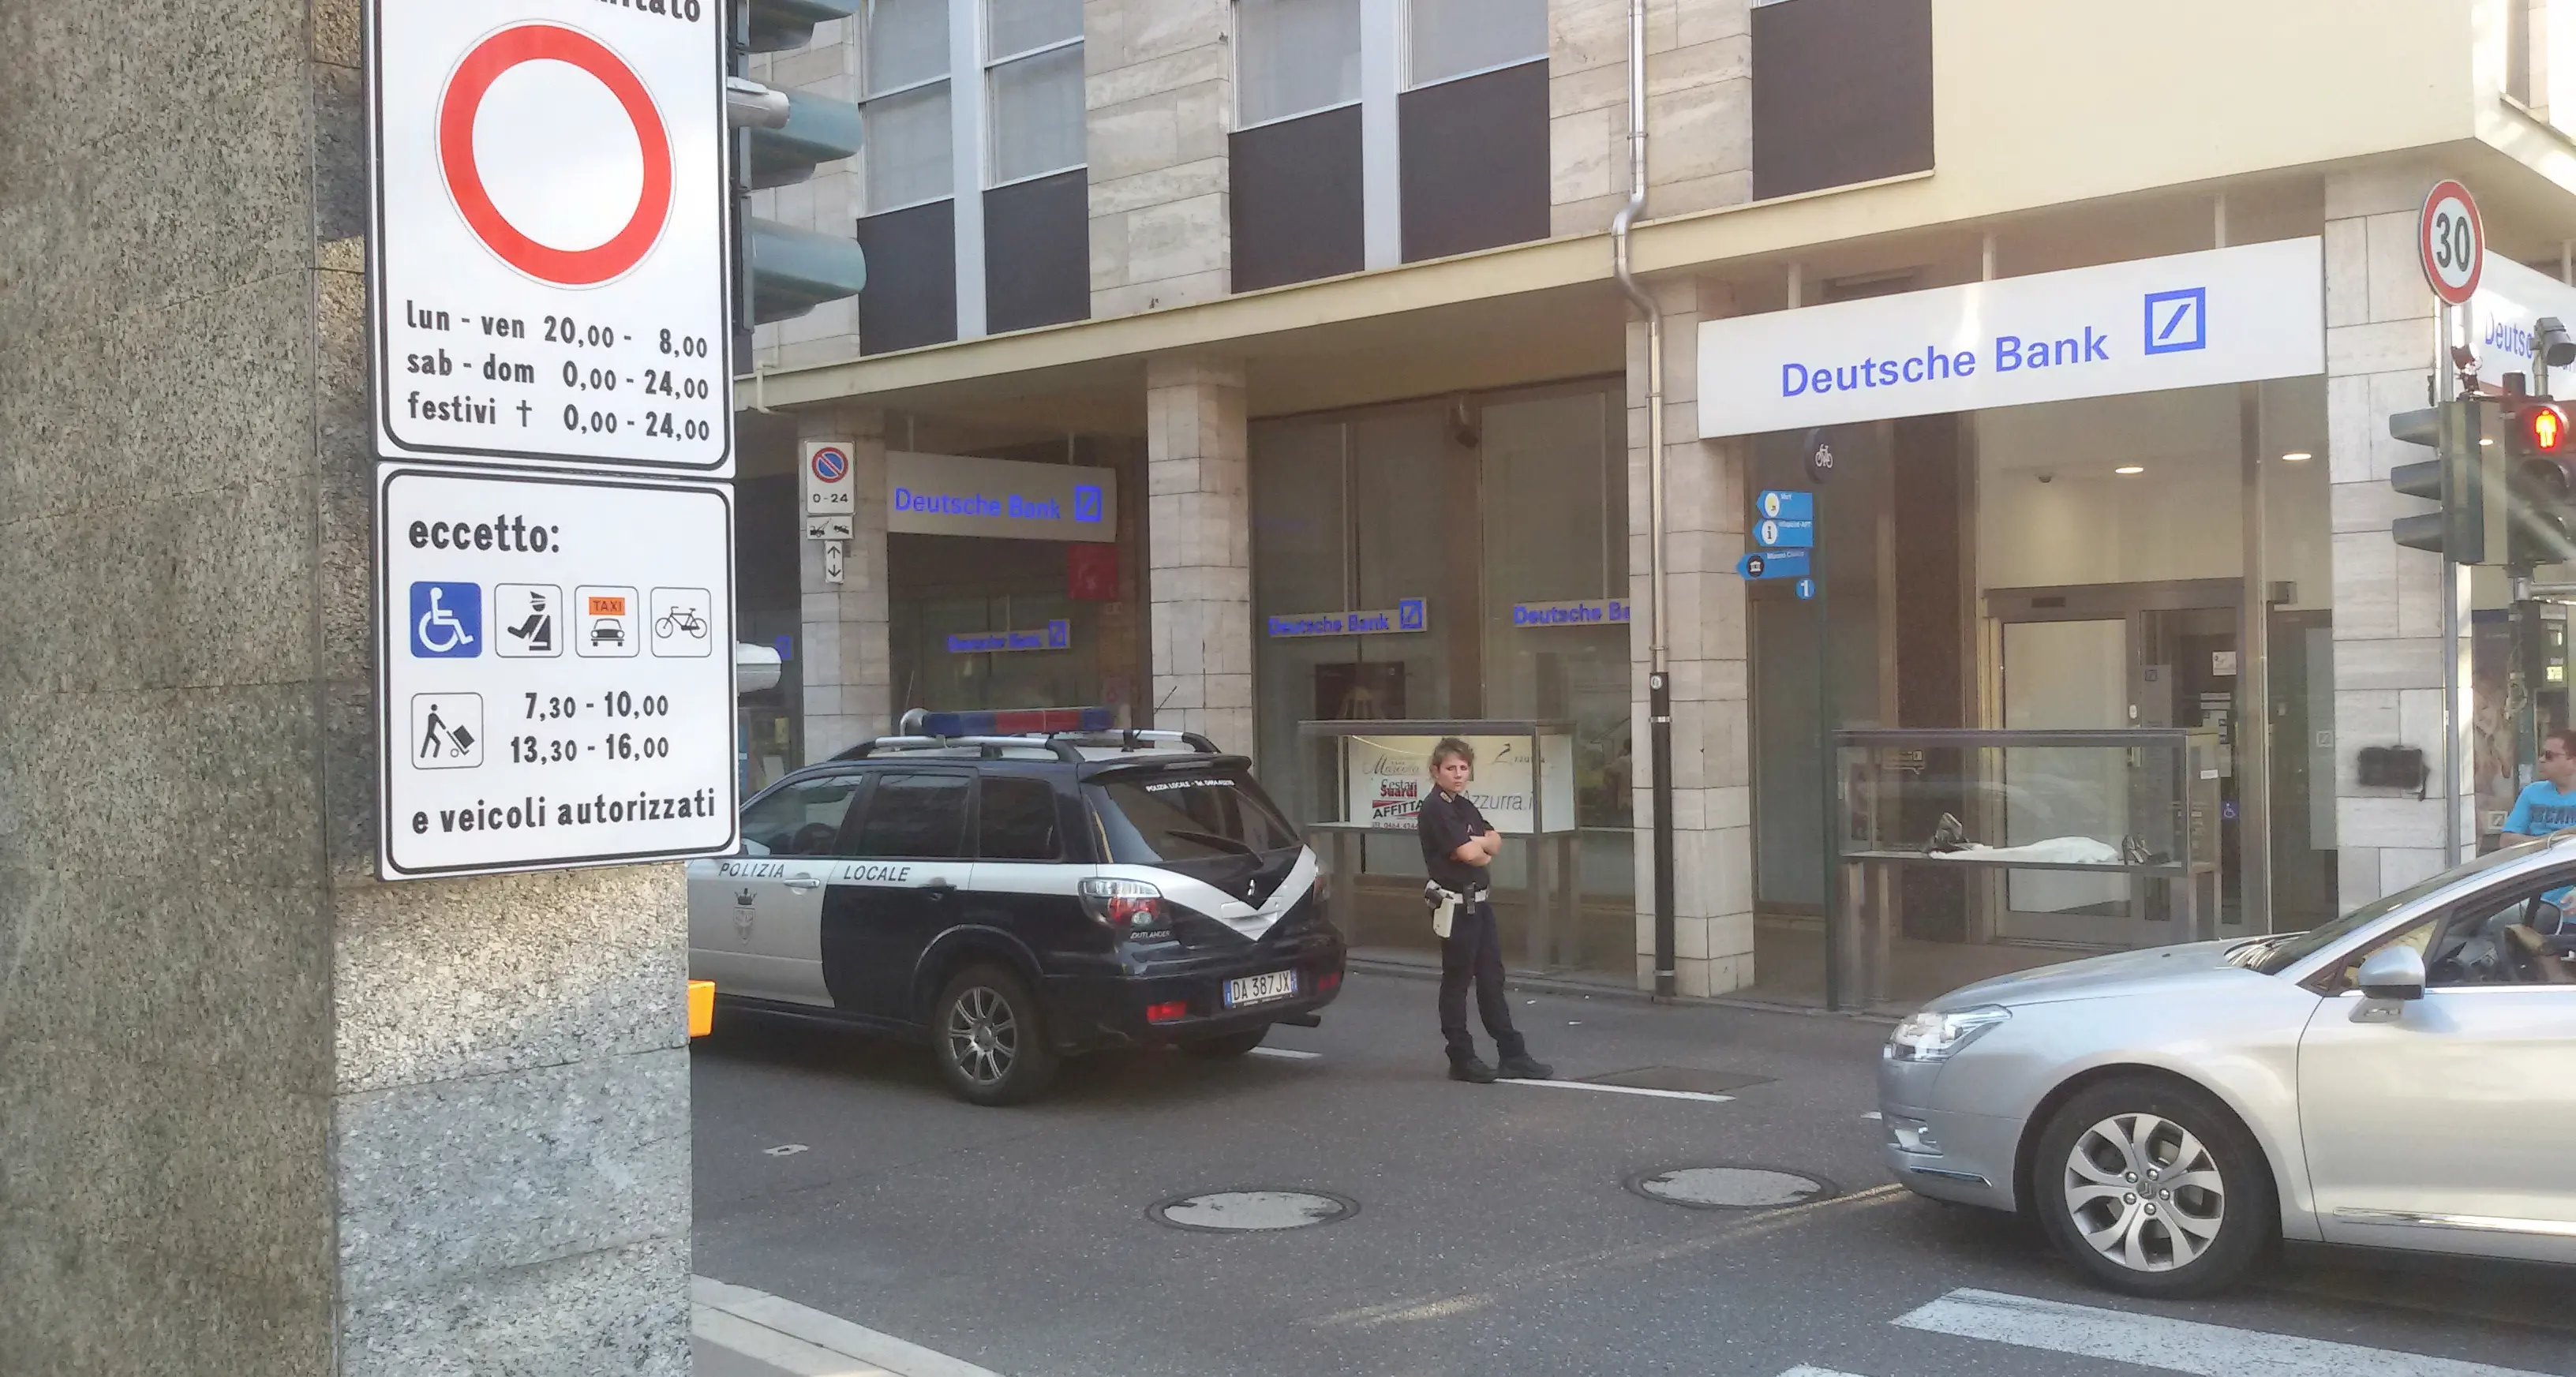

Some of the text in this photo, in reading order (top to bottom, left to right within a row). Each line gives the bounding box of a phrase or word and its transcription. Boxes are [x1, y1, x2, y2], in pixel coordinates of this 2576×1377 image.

[2436, 212, 2470, 271] 30
[406, 299, 450, 331] lun
[481, 316, 525, 339] ven
[544, 315, 614, 349] 20,00
[659, 327, 707, 358] 8,00
[406, 348, 452, 376] sab
[483, 353, 534, 384] dom
[563, 360, 616, 391] 0,00
[644, 369, 709, 400] 24,00
[1782, 326, 2109, 398] Deutsche Bank
[407, 391, 496, 425] festivi
[563, 403, 617, 434] 0,00
[645, 410, 710, 442] 24,00
[894, 487, 1061, 519] Deutsche Bank
[408, 514, 560, 553] eccetto:
[1800, 579, 1810, 597] 1
[593, 601, 623, 612] TAXI
[1513, 604, 1602, 625] Deutsche
[1267, 613, 1390, 636] Deutsche Bank
[525, 692, 576, 722] 7,30
[604, 690, 668, 720] 10,00
[510, 735, 577, 765] 13,30
[605, 732, 669, 761] 16,00
[1380, 785, 1417, 798] Suardi
[412, 788, 714, 835] e veicoli autorizzati
[718, 862, 911, 882] POLIZIA LOCALE
[1233, 980, 1248, 1001] DA
[1252, 975, 1274, 997] 387
[1276, 971, 1290, 993] JX
